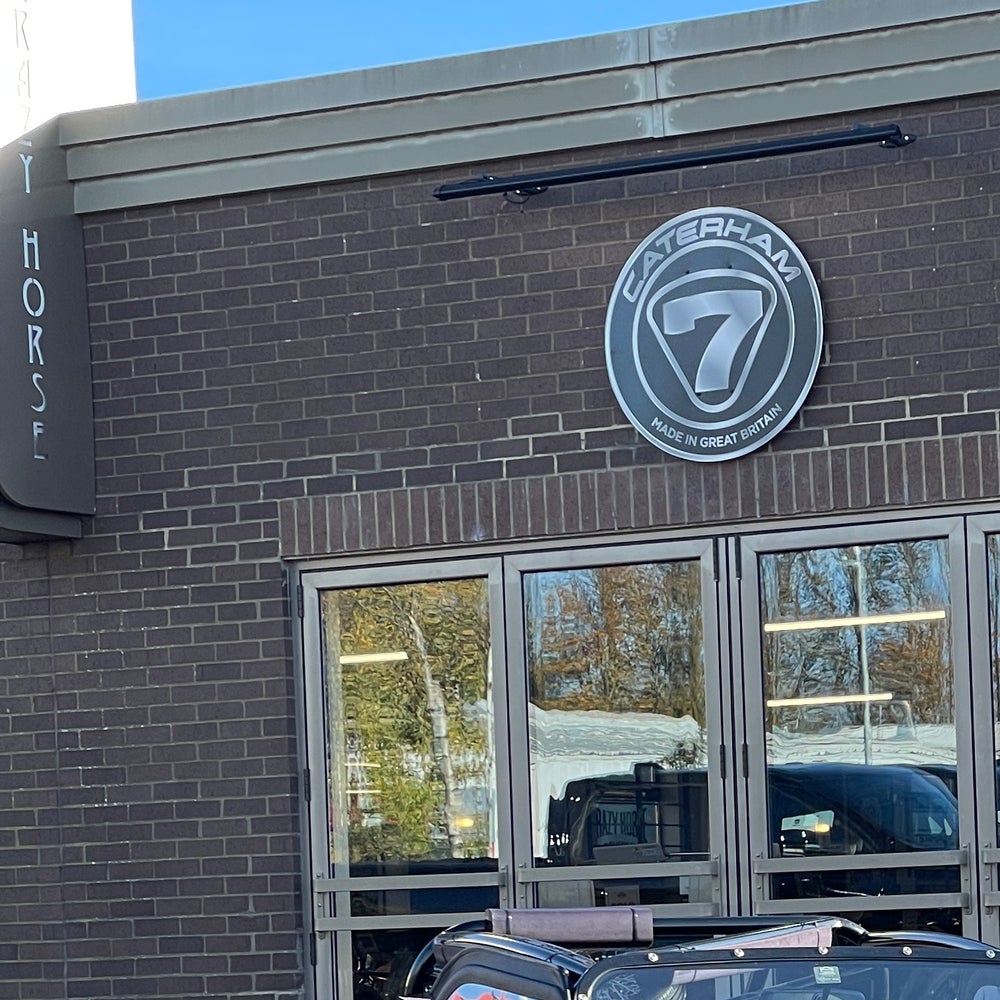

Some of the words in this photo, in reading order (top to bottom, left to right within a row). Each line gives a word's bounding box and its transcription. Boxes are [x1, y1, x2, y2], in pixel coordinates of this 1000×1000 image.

[14, 0, 33, 194] RAZY
[622, 217, 802, 303] CATERHAM
[22, 228, 48, 460] HORSE
[662, 289, 764, 393] 7
[651, 416, 684, 444] MADE
[685, 434, 698, 447] IN
[699, 431, 739, 448] GREAT
[741, 402, 783, 440] BRITAIN
